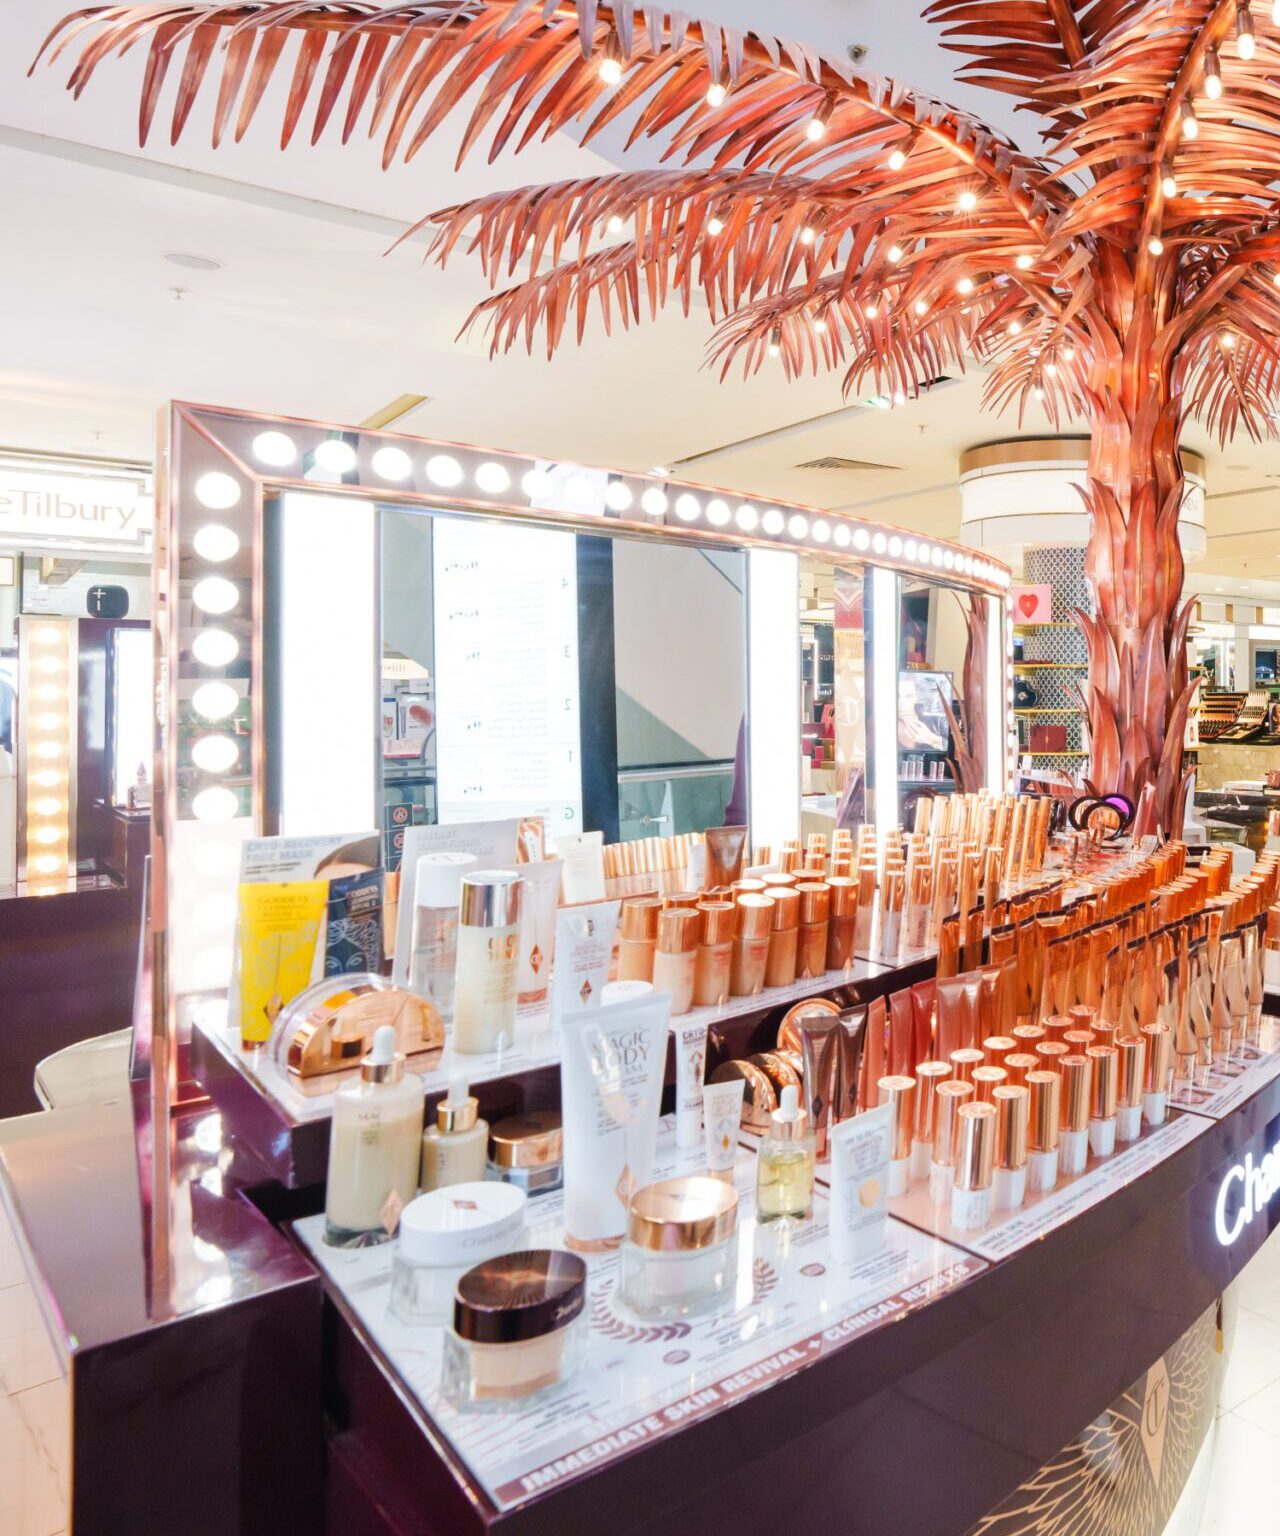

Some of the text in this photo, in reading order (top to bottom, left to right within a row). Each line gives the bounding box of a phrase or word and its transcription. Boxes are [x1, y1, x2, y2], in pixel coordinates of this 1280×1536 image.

[520, 1414, 665, 1493] IMMEDIATE
[663, 1386, 721, 1422] SKIN
[720, 1347, 807, 1393] REVIVAL
[822, 1299, 904, 1342] CLINICAL
